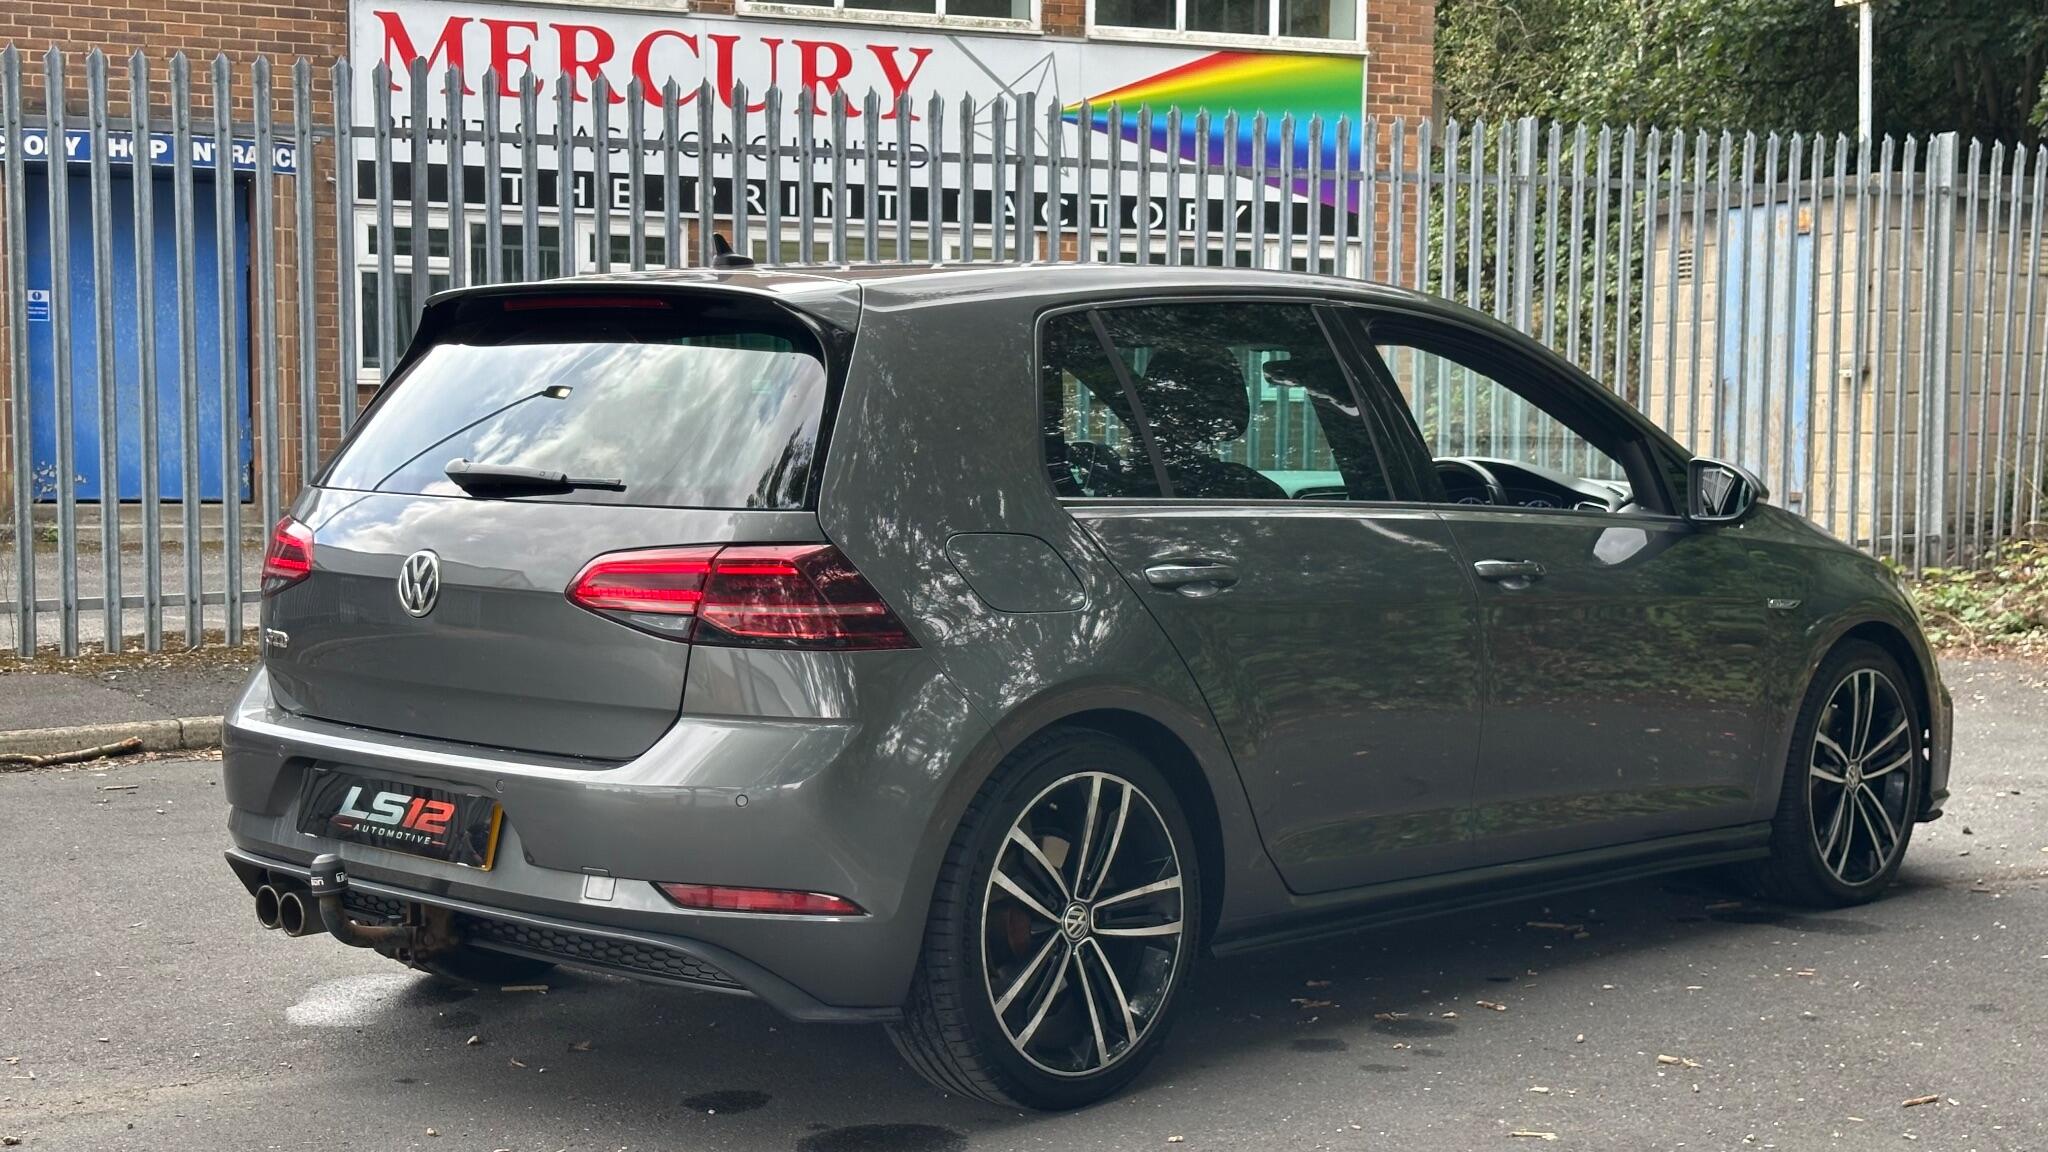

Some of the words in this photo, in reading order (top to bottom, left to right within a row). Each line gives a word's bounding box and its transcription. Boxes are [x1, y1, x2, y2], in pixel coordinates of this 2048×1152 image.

[373, 10, 933, 121] MERCURY
[499, 173, 631, 208] THE
[694, 181, 899, 220] PRINT
[956, 193, 1249, 232] ACTORY
[339, 785, 455, 834] LS12
[353, 823, 431, 845] AUTOMOTIVE
